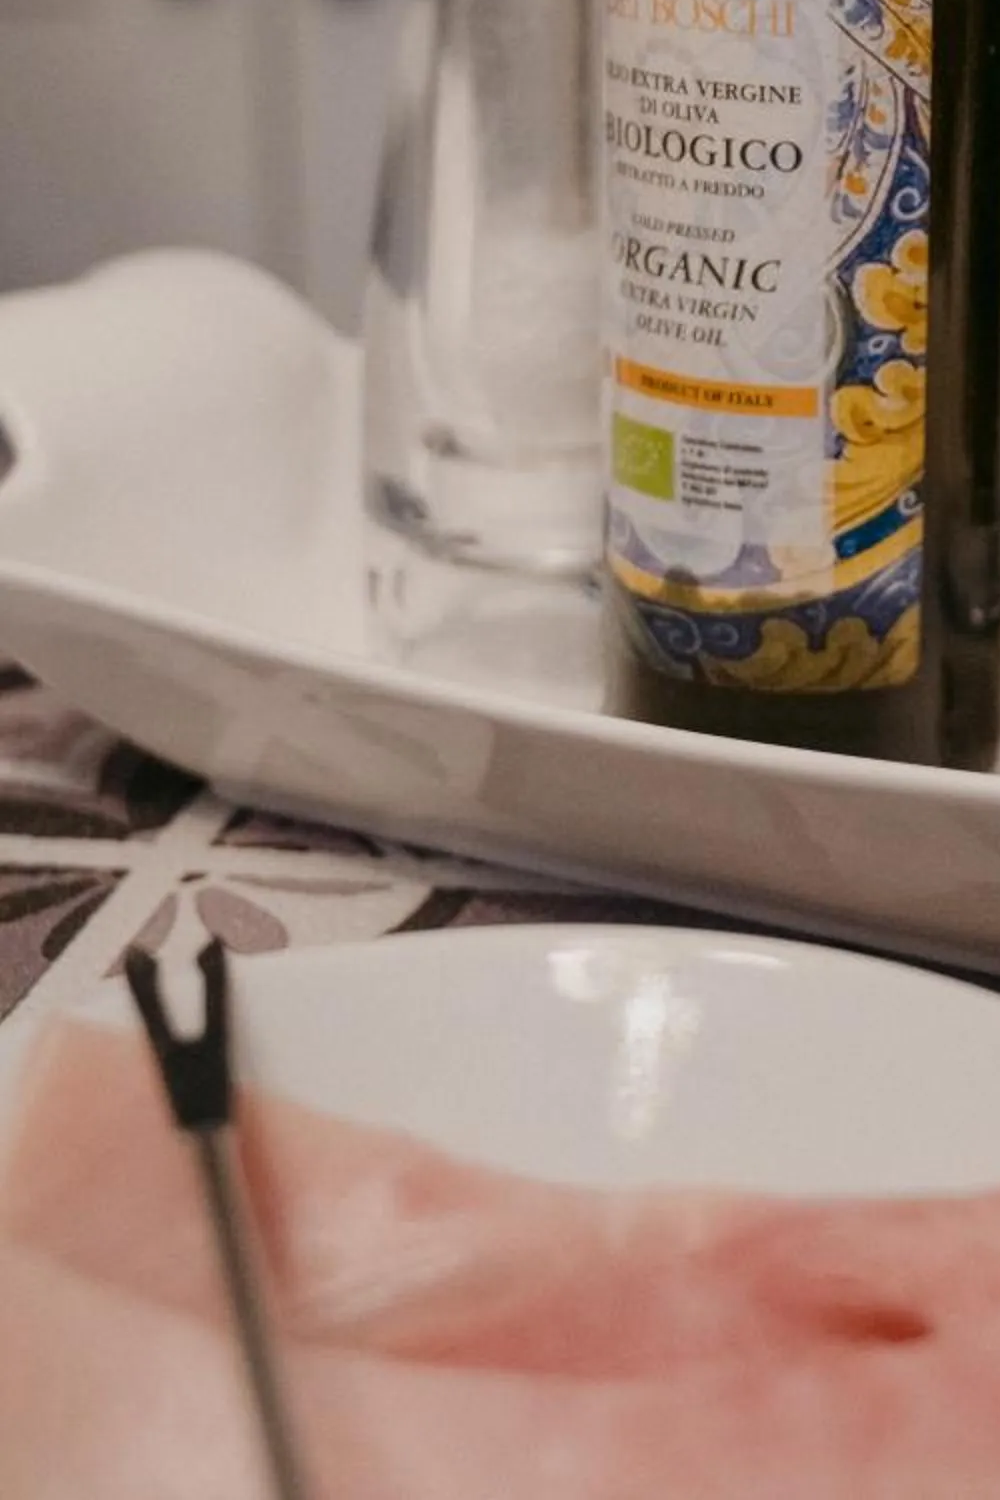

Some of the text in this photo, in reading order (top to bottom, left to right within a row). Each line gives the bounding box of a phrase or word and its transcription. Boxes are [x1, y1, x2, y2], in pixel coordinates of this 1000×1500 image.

[631, 67, 689, 95] EXTRA
[696, 78, 803, 105] VERGINE
[640, 96, 720, 125] DI OLIVA
[606, 110, 803, 173] BIOLOGICO
[679, 178, 690, 192] A
[693, 179, 766, 199] FREDDO
[666, 220, 736, 244] PRESSED
[611, 230, 782, 294] ORGANIC
[676, 296, 759, 322] VIRGIN
[636, 313, 728, 347] OLIVE OIL
